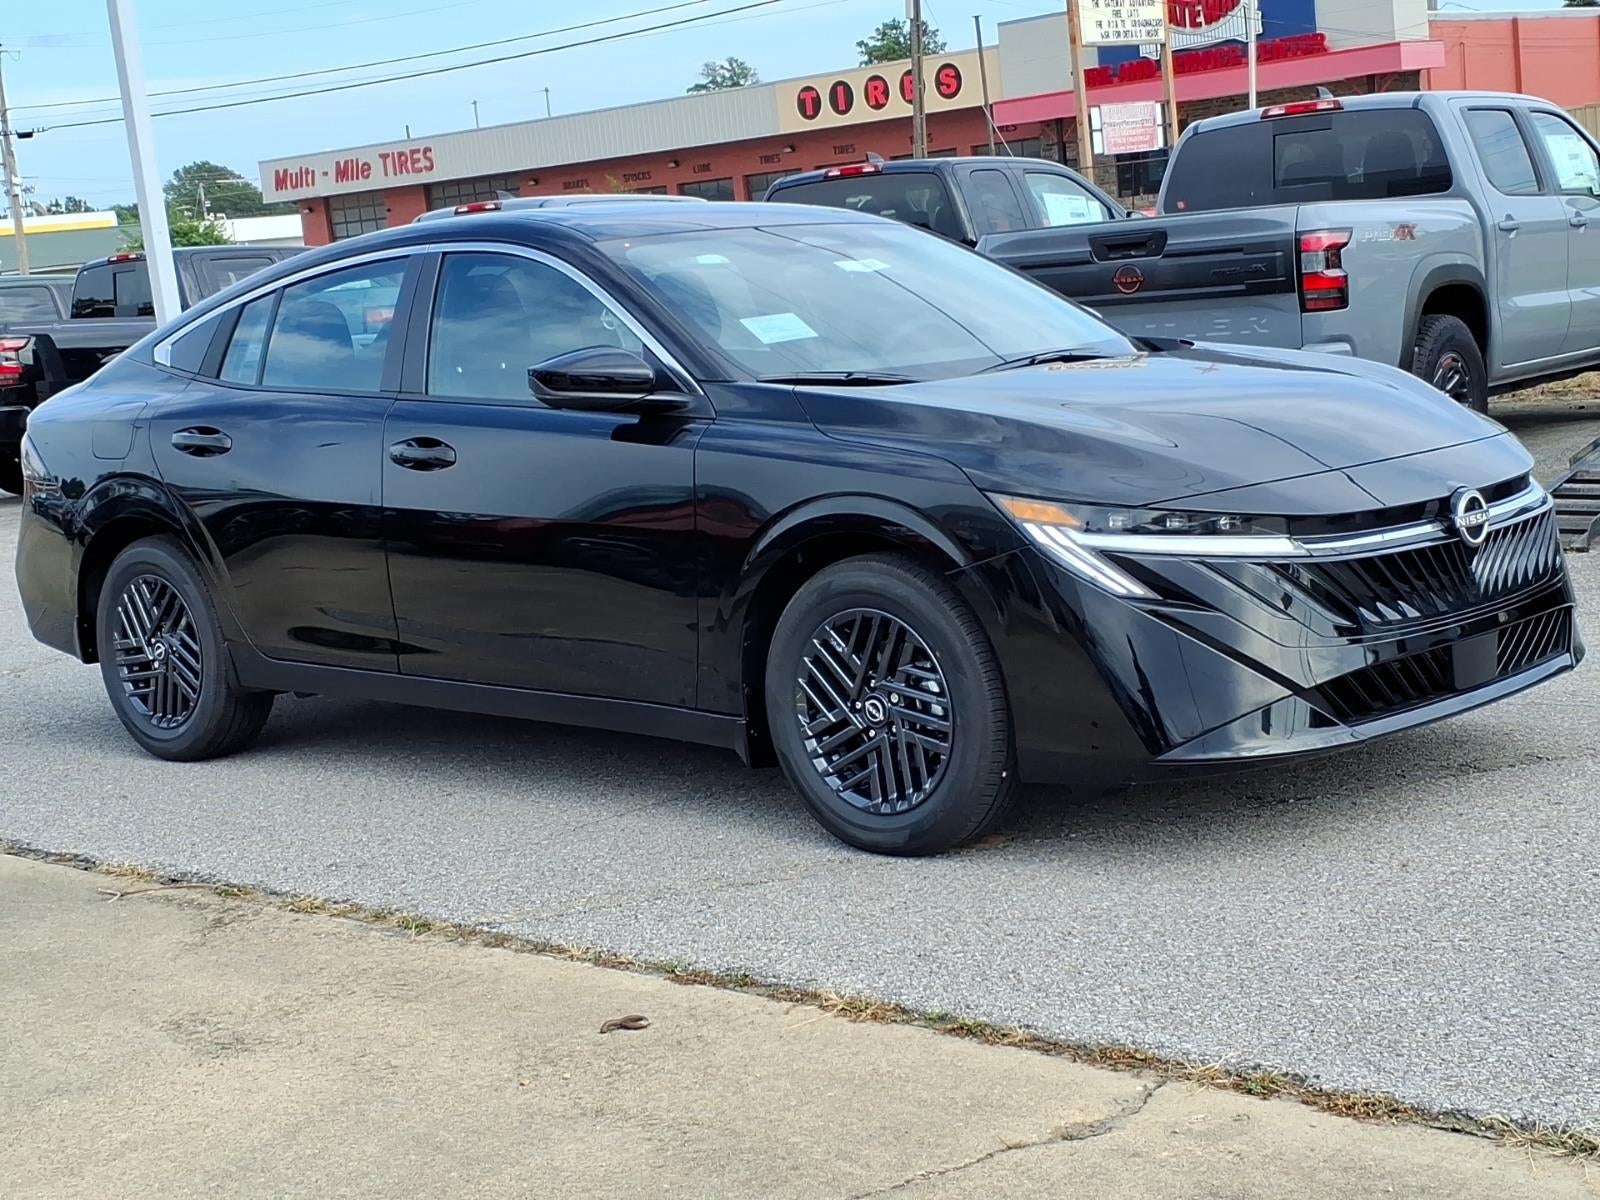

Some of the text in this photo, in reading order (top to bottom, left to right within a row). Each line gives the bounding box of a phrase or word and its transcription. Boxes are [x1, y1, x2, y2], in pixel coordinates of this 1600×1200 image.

[800, 68, 957, 117] TIRES
[274, 166, 316, 191] Multi
[335, 157, 372, 183] Mile
[378, 146, 434, 177] TIRES
